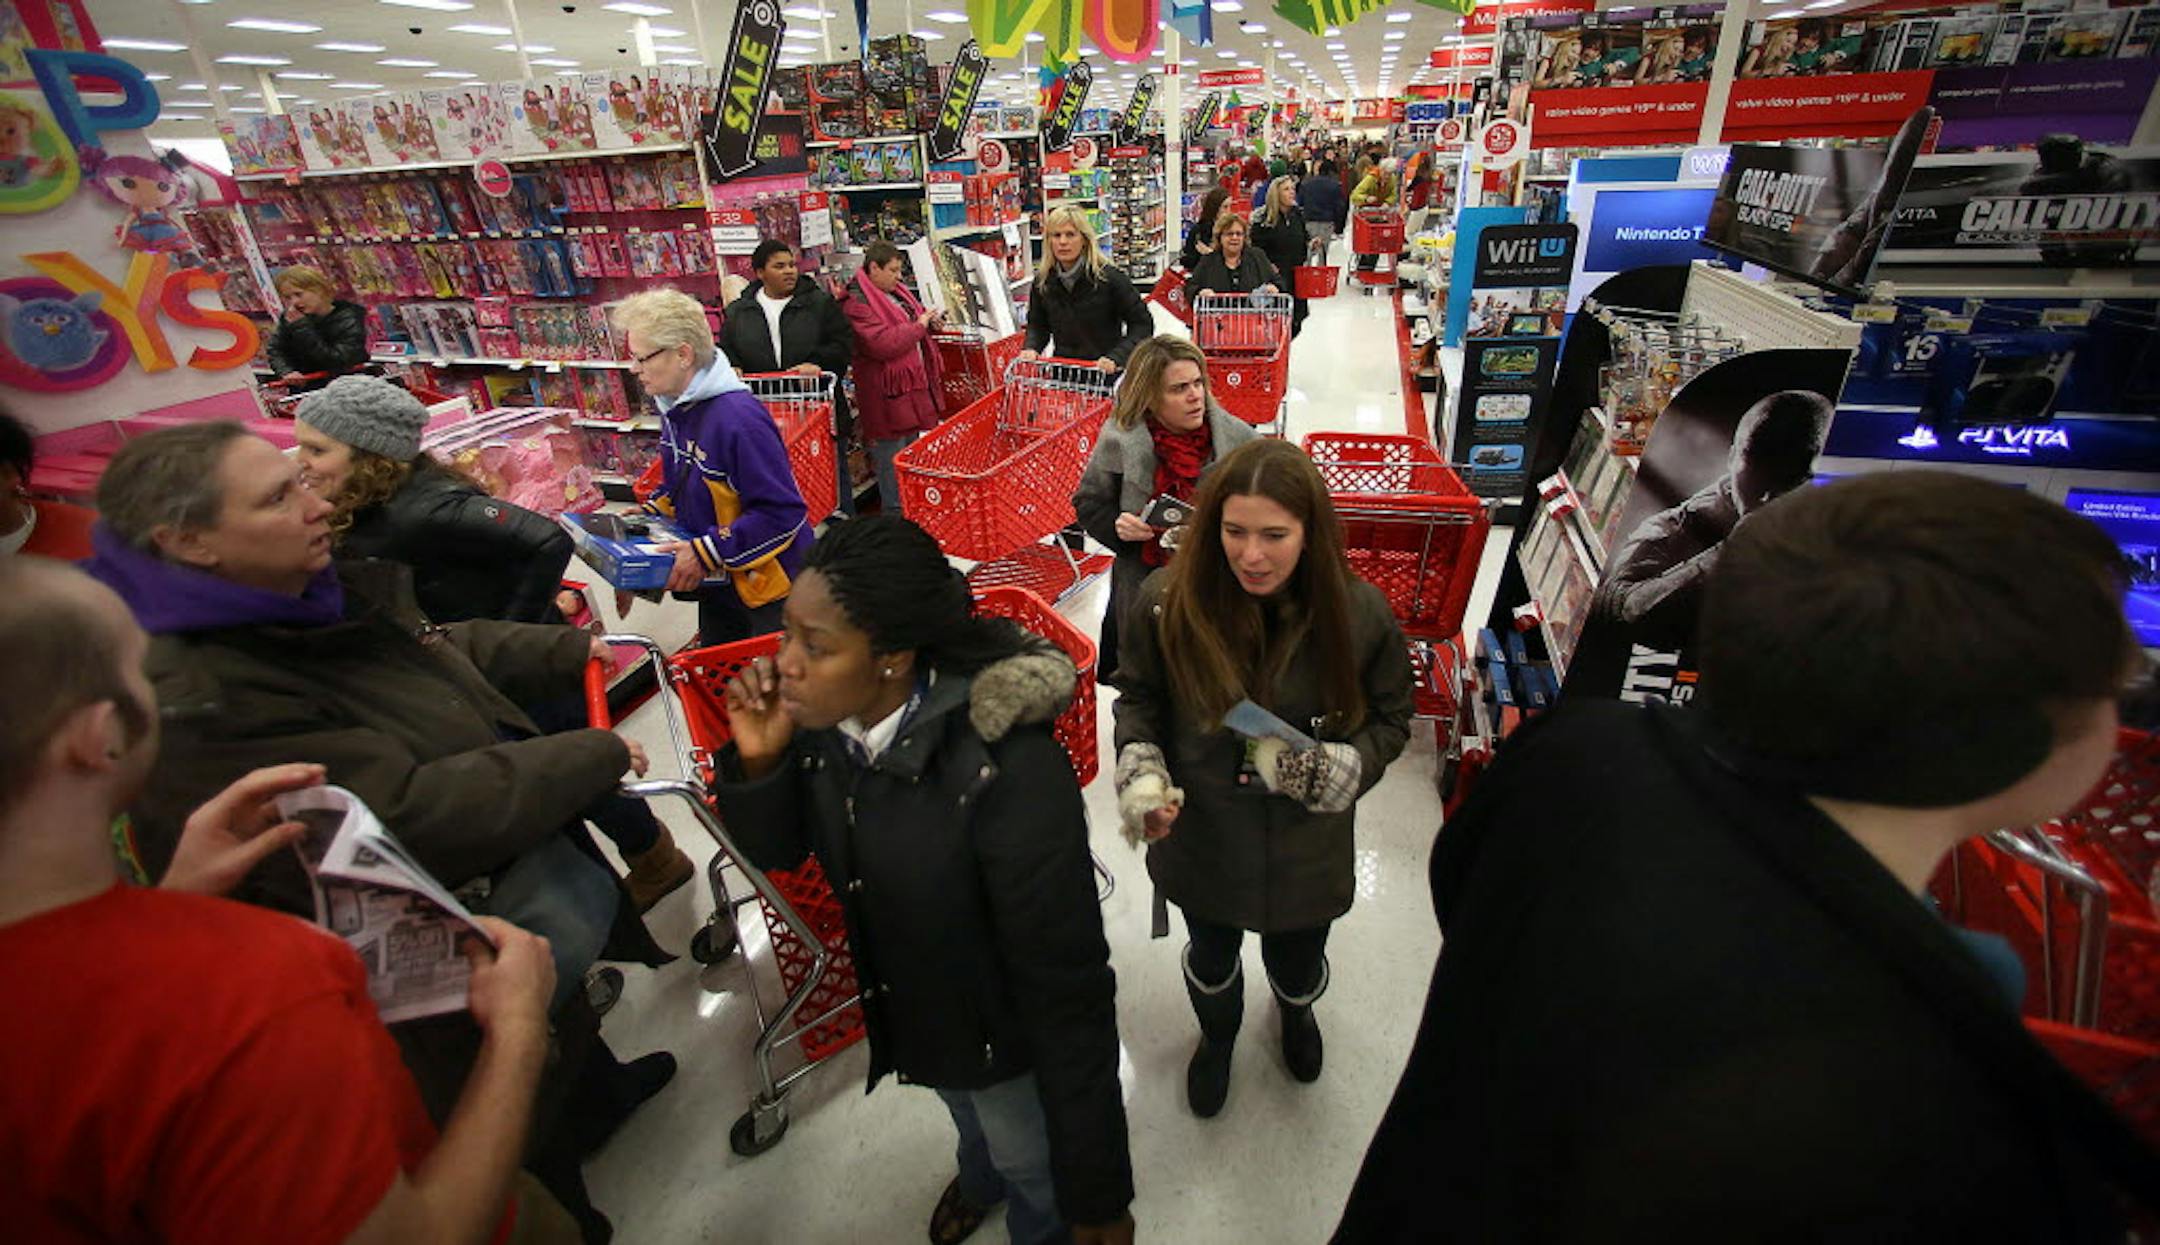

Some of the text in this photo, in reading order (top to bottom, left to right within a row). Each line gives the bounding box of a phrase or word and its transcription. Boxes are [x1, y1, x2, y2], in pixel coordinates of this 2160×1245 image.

[724, 35, 769, 134] SALE
[942, 64, 978, 130] SALE
[1056, 82, 1083, 128] SALE
[1765, 96, 1793, 107] video
[1735, 168, 1772, 203] CALL
[1774, 173, 1826, 215] DUTY
[1961, 199, 2050, 232] CALL
[2056, 196, 2160, 232] DUTY
[1615, 225, 1690, 241] Nintendo
[1737, 203, 1771, 227] BLACK
[1771, 209, 1794, 232] OPS
[1488, 237, 1567, 264] Wii U
[0, 251, 262, 393] OYS
[1619, 642, 1681, 707] UTY
